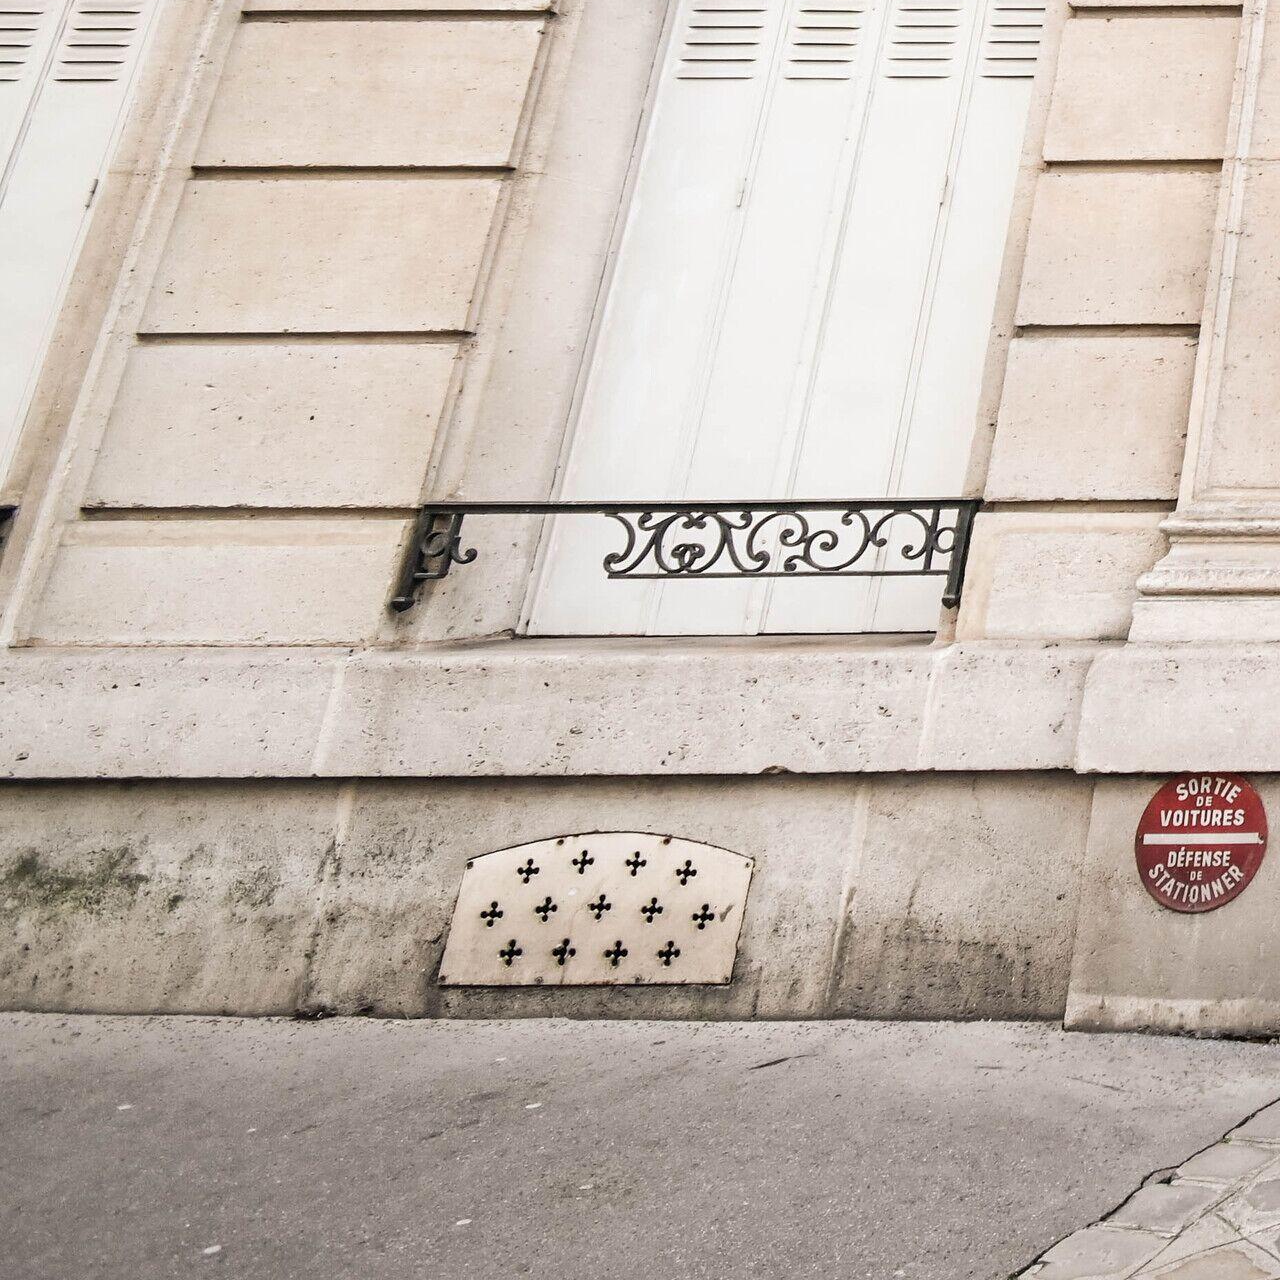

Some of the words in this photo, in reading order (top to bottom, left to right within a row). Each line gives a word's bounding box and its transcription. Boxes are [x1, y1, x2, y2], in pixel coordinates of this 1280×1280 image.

[1176, 776, 1242, 804] SORTIE
[1196, 796, 1213, 807] DE
[1160, 809, 1245, 827] VOITURES
[1167, 847, 1231, 867] DÉFENSE
[1149, 863, 1244, 904] STATIONNER
[1189, 870, 1203, 881] DE
